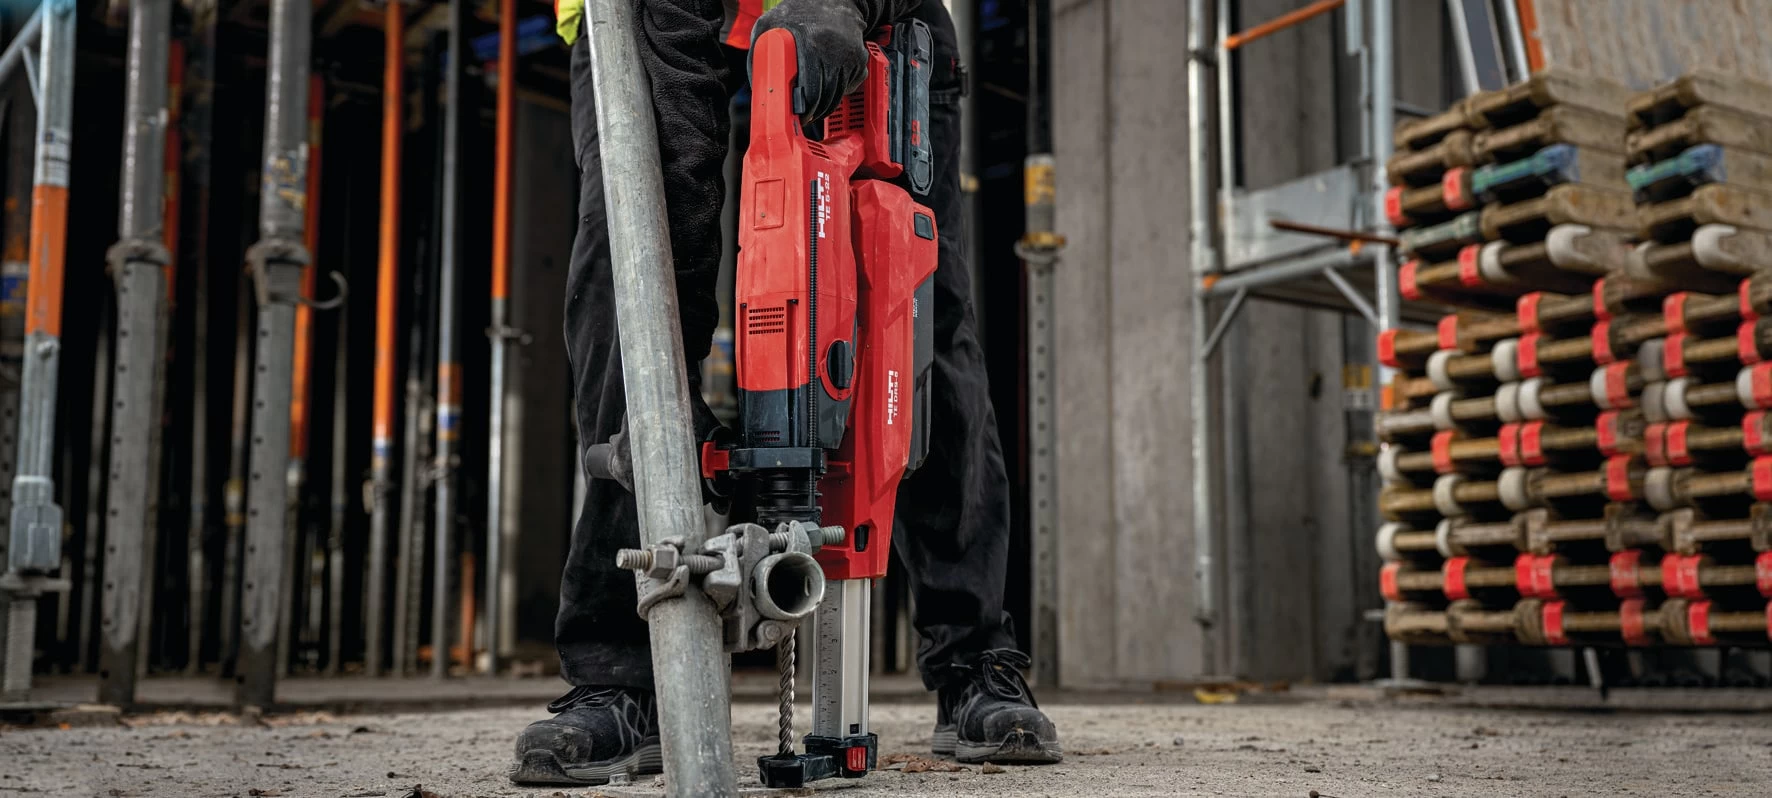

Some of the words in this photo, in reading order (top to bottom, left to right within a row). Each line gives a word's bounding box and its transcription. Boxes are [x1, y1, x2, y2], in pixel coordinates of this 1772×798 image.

[817, 171, 826, 239] HILTI
[825, 205, 831, 221] TE
[893, 405, 898, 418] TE
